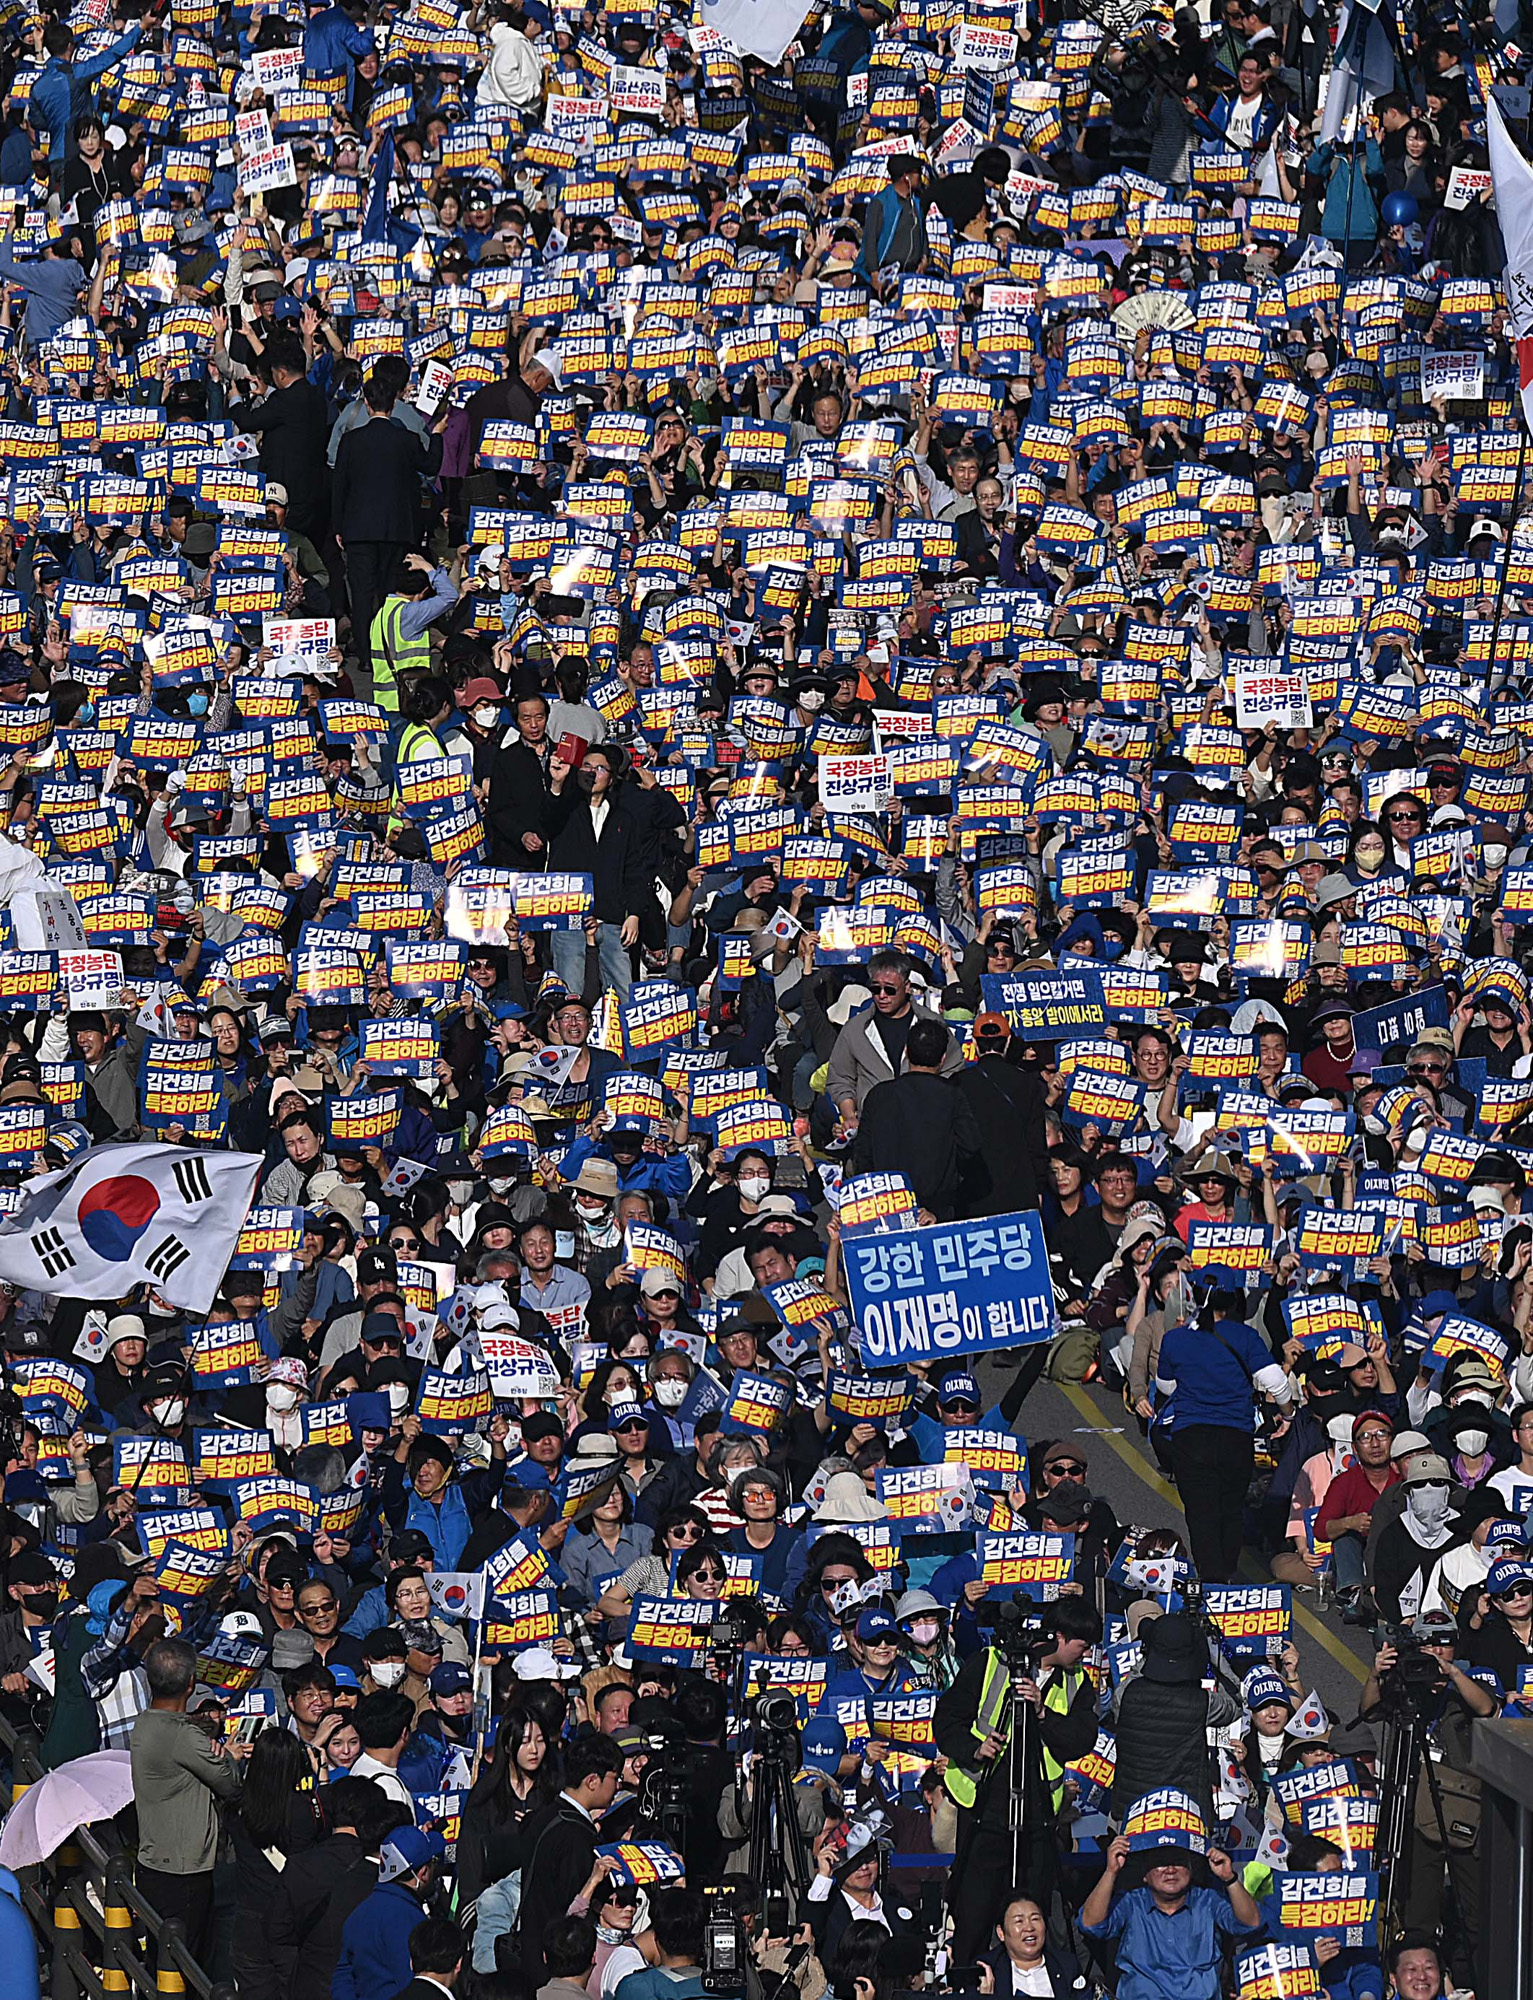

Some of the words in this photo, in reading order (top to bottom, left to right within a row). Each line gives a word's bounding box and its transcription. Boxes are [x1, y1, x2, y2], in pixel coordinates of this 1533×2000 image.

[1458, 175, 1491, 187] 국정농
[1205, 347, 1263, 363] 특검하라!
[1427, 357, 1476, 369] 국정농단
[1424, 367, 1482, 389] 진상규명!
[101, 408, 159, 426] 김건희를
[101, 424, 164, 441] 특검하라!
[587, 430, 649, 445] 특검하라!
[202, 470, 258, 486] 김건희를
[1461, 468, 1517, 483] 김건희를
[202, 486, 264, 502] 특검하라!
[568, 486, 624, 500] 김건희를
[89, 497, 152, 512] 특검하라!
[569, 501, 631, 515] 특검하라!
[811, 502, 874, 517] 특검하라!
[221, 529, 279, 542] 김건희를
[220, 543, 285, 554] 특검하라!
[860, 541, 914, 561] 김건희를
[861, 558, 920, 577] 특검하라!
[216, 576, 275, 593] 김건희를
[843, 582, 902, 596] 김건희를
[1427, 580, 1481, 597] 특검하라!
[216, 594, 281, 612] 특검하라!
[843, 593, 909, 606] 특검하라!
[1294, 598, 1354, 617] 김건희를
[1293, 618, 1361, 635] 특검하라!
[1102, 665, 1157, 684] 김건희를
[236, 681, 293, 697] 김건희를
[1244, 678, 1301, 694] 국정농단
[236, 700, 298, 715] 특검하라!
[324, 702, 379, 717] 김건희를
[1245, 694, 1304, 713] 진상규명!
[134, 722, 196, 738] 김건희를
[328, 716, 389, 731] 특검하라!
[132, 740, 200, 756] 특검하라!
[891, 745, 950, 765] 김건희를
[399, 759, 462, 784] 김건희를
[828, 758, 887, 777] 국정농단
[894, 761, 958, 782] 특검하라!
[269, 776, 326, 799] 김건희를
[403, 776, 471, 802] 특검하라!
[828, 776, 888, 797] 진상규명!
[1470, 775, 1524, 793] 김건희를
[958, 787, 1021, 801] 김건희를
[1034, 796, 1099, 811] 특검하라!
[1465, 792, 1526, 810] 특검하라!
[959, 803, 1029, 816] 특검하라!
[1176, 805, 1235, 824] 김건희를
[58, 827, 117, 852] 특검하라!
[1171, 823, 1240, 842] 특검하라!
[432, 826, 484, 860] 특검하라!
[783, 860, 848, 878] 특검하라!
[1062, 854, 1125, 876] 김건희를
[1062, 872, 1133, 894] 특검하라!
[82, 896, 145, 915] 김건희를
[517, 895, 590, 915] 특검하라!
[83, 914, 153, 930] 특검하라!
[392, 943, 459, 964] 김건희를
[392, 963, 464, 982] 특검하라!
[0, 974, 58, 995] 검하라!
[1001, 982, 1027, 1003] 전쟁
[626, 993, 688, 1027] 김건희를
[630, 1011, 696, 1045] 특검하라!
[1193, 1037, 1253, 1055] 김건희를
[1190, 1057, 1259, 1076] 특검하라!
[147, 1073, 213, 1092] 김건희를
[1073, 1072, 1138, 1099] 김건희를
[147, 1093, 219, 1113] 특검하라!
[331, 1094, 396, 1118] 김건희를
[1069, 1092, 1139, 1120] 특검하라!
[332, 1113, 400, 1137] 특검하라!
[717, 1104, 782, 1130] 김건희를
[719, 1121, 791, 1145] 특검하라!
[1365, 1179, 1389, 1190] 이재명
[841, 1193, 915, 1223] 특검하라!
[1304, 1211, 1375, 1232] 김건희를
[239, 1230, 301, 1252] 검하라!
[1194, 1227, 1264, 1246] 김건희를
[1301, 1233, 1381, 1254] 특검하라!
[858, 1241, 923, 1292] 강한
[933, 1224, 1031, 1281] 민주당
[864, 1291, 983, 1356] 이재명이
[987, 1296, 1049, 1335] 합니다
[482, 1340, 544, 1359] 국정농단
[485, 1358, 551, 1377] 진상규명!
[833, 1377, 906, 1396] 김건희를
[946, 1379, 973, 1392] 이재명
[614, 1404, 644, 1419] 이재명
[831, 1394, 912, 1416] 특검하라!
[200, 1433, 269, 1455] 김건희를
[945, 1430, 1017, 1451] 김건희를
[242, 1496, 319, 1517] 특검하라!
[143, 1511, 215, 1537] 김건희를
[1493, 1524, 1522, 1540] 이재명
[984, 1535, 1062, 1560] 김건희를
[983, 1559, 1070, 1582] 특검하라!
[1496, 1564, 1527, 1582] 이재명
[1207, 1588, 1282, 1612] 김건희를
[638, 1602, 713, 1623] 김건희를
[1254, 1681, 1283, 1695] 이재명
[1282, 1876, 1366, 1901] 김건희를
[1281, 1900, 1374, 1926] 특검하라!
